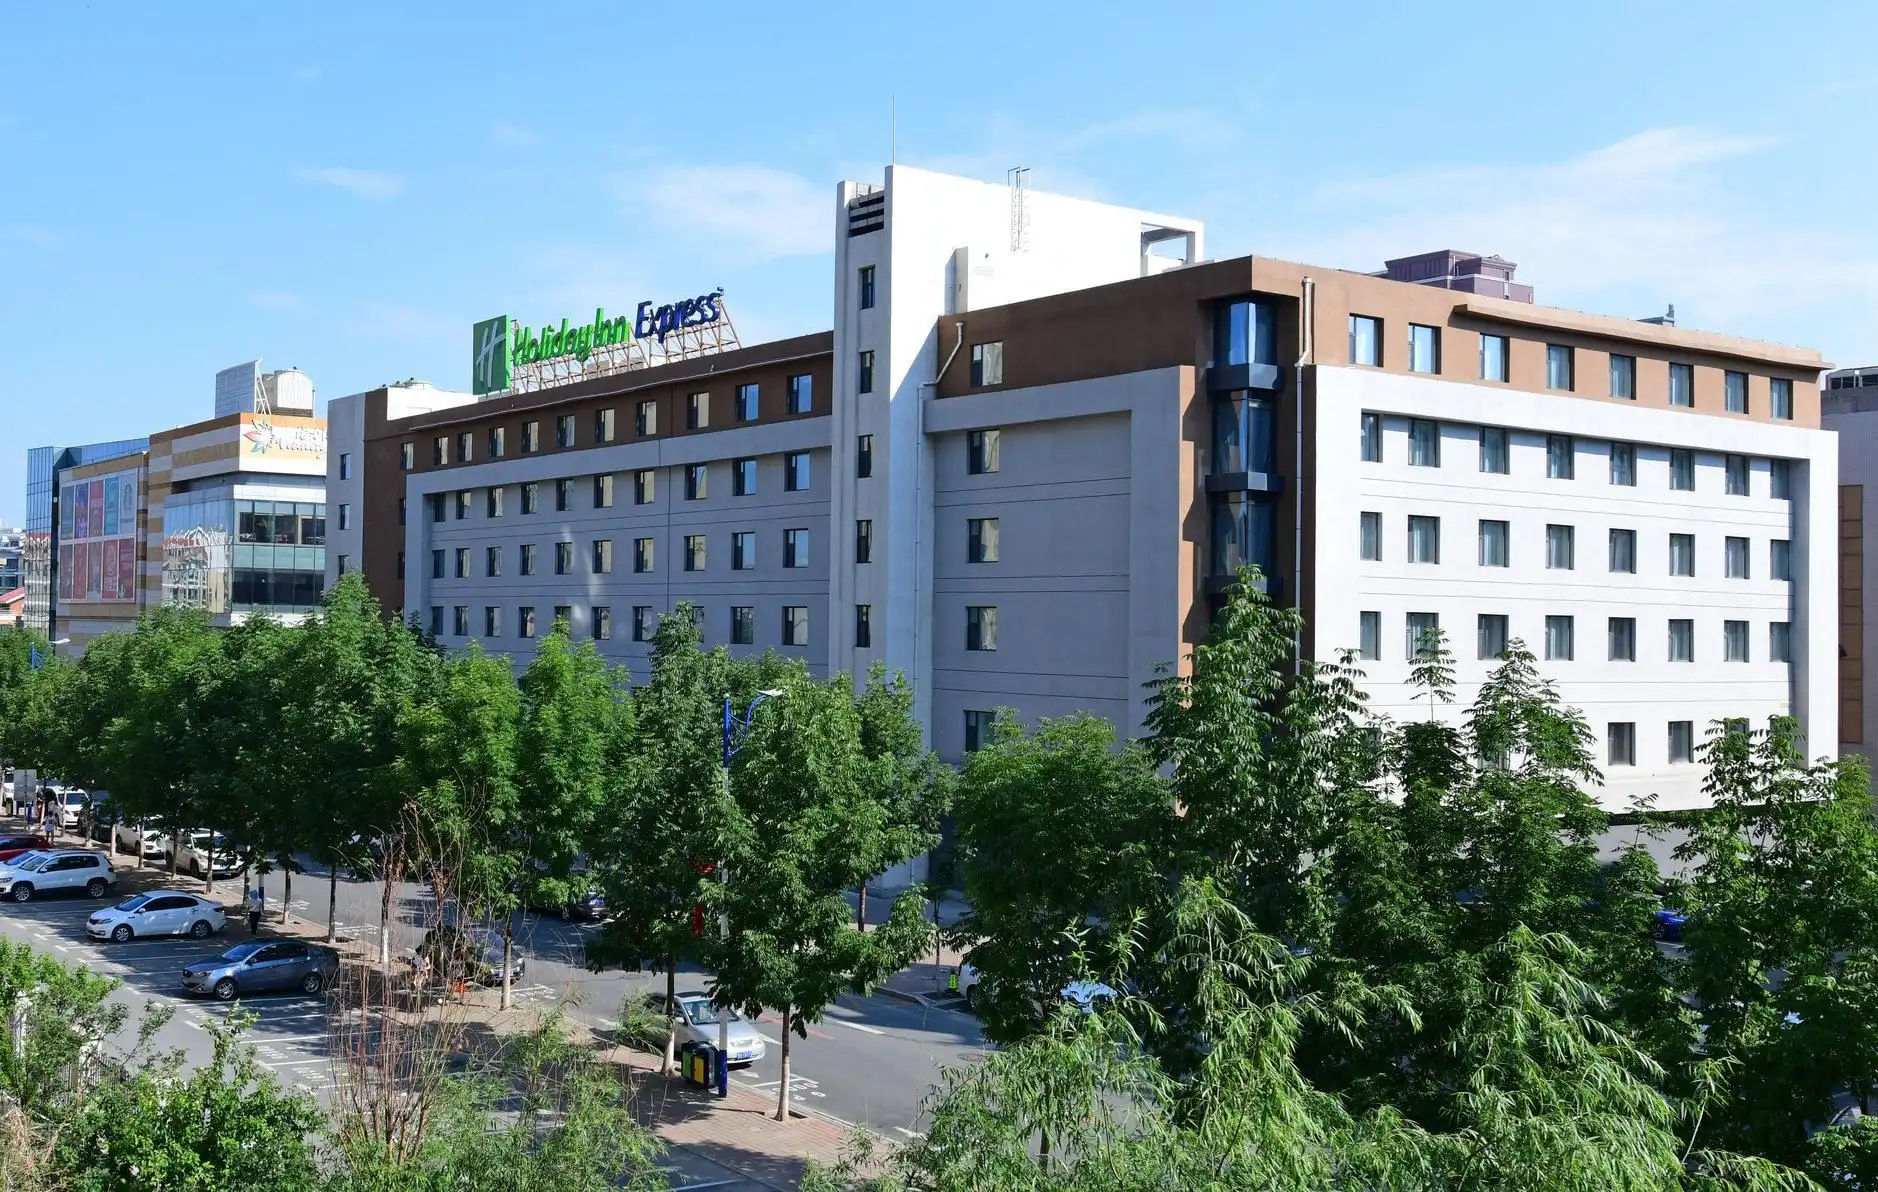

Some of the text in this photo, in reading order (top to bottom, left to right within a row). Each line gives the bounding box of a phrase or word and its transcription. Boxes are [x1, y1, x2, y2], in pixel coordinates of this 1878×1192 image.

[512, 287, 724, 367] Holiday Inn Express
